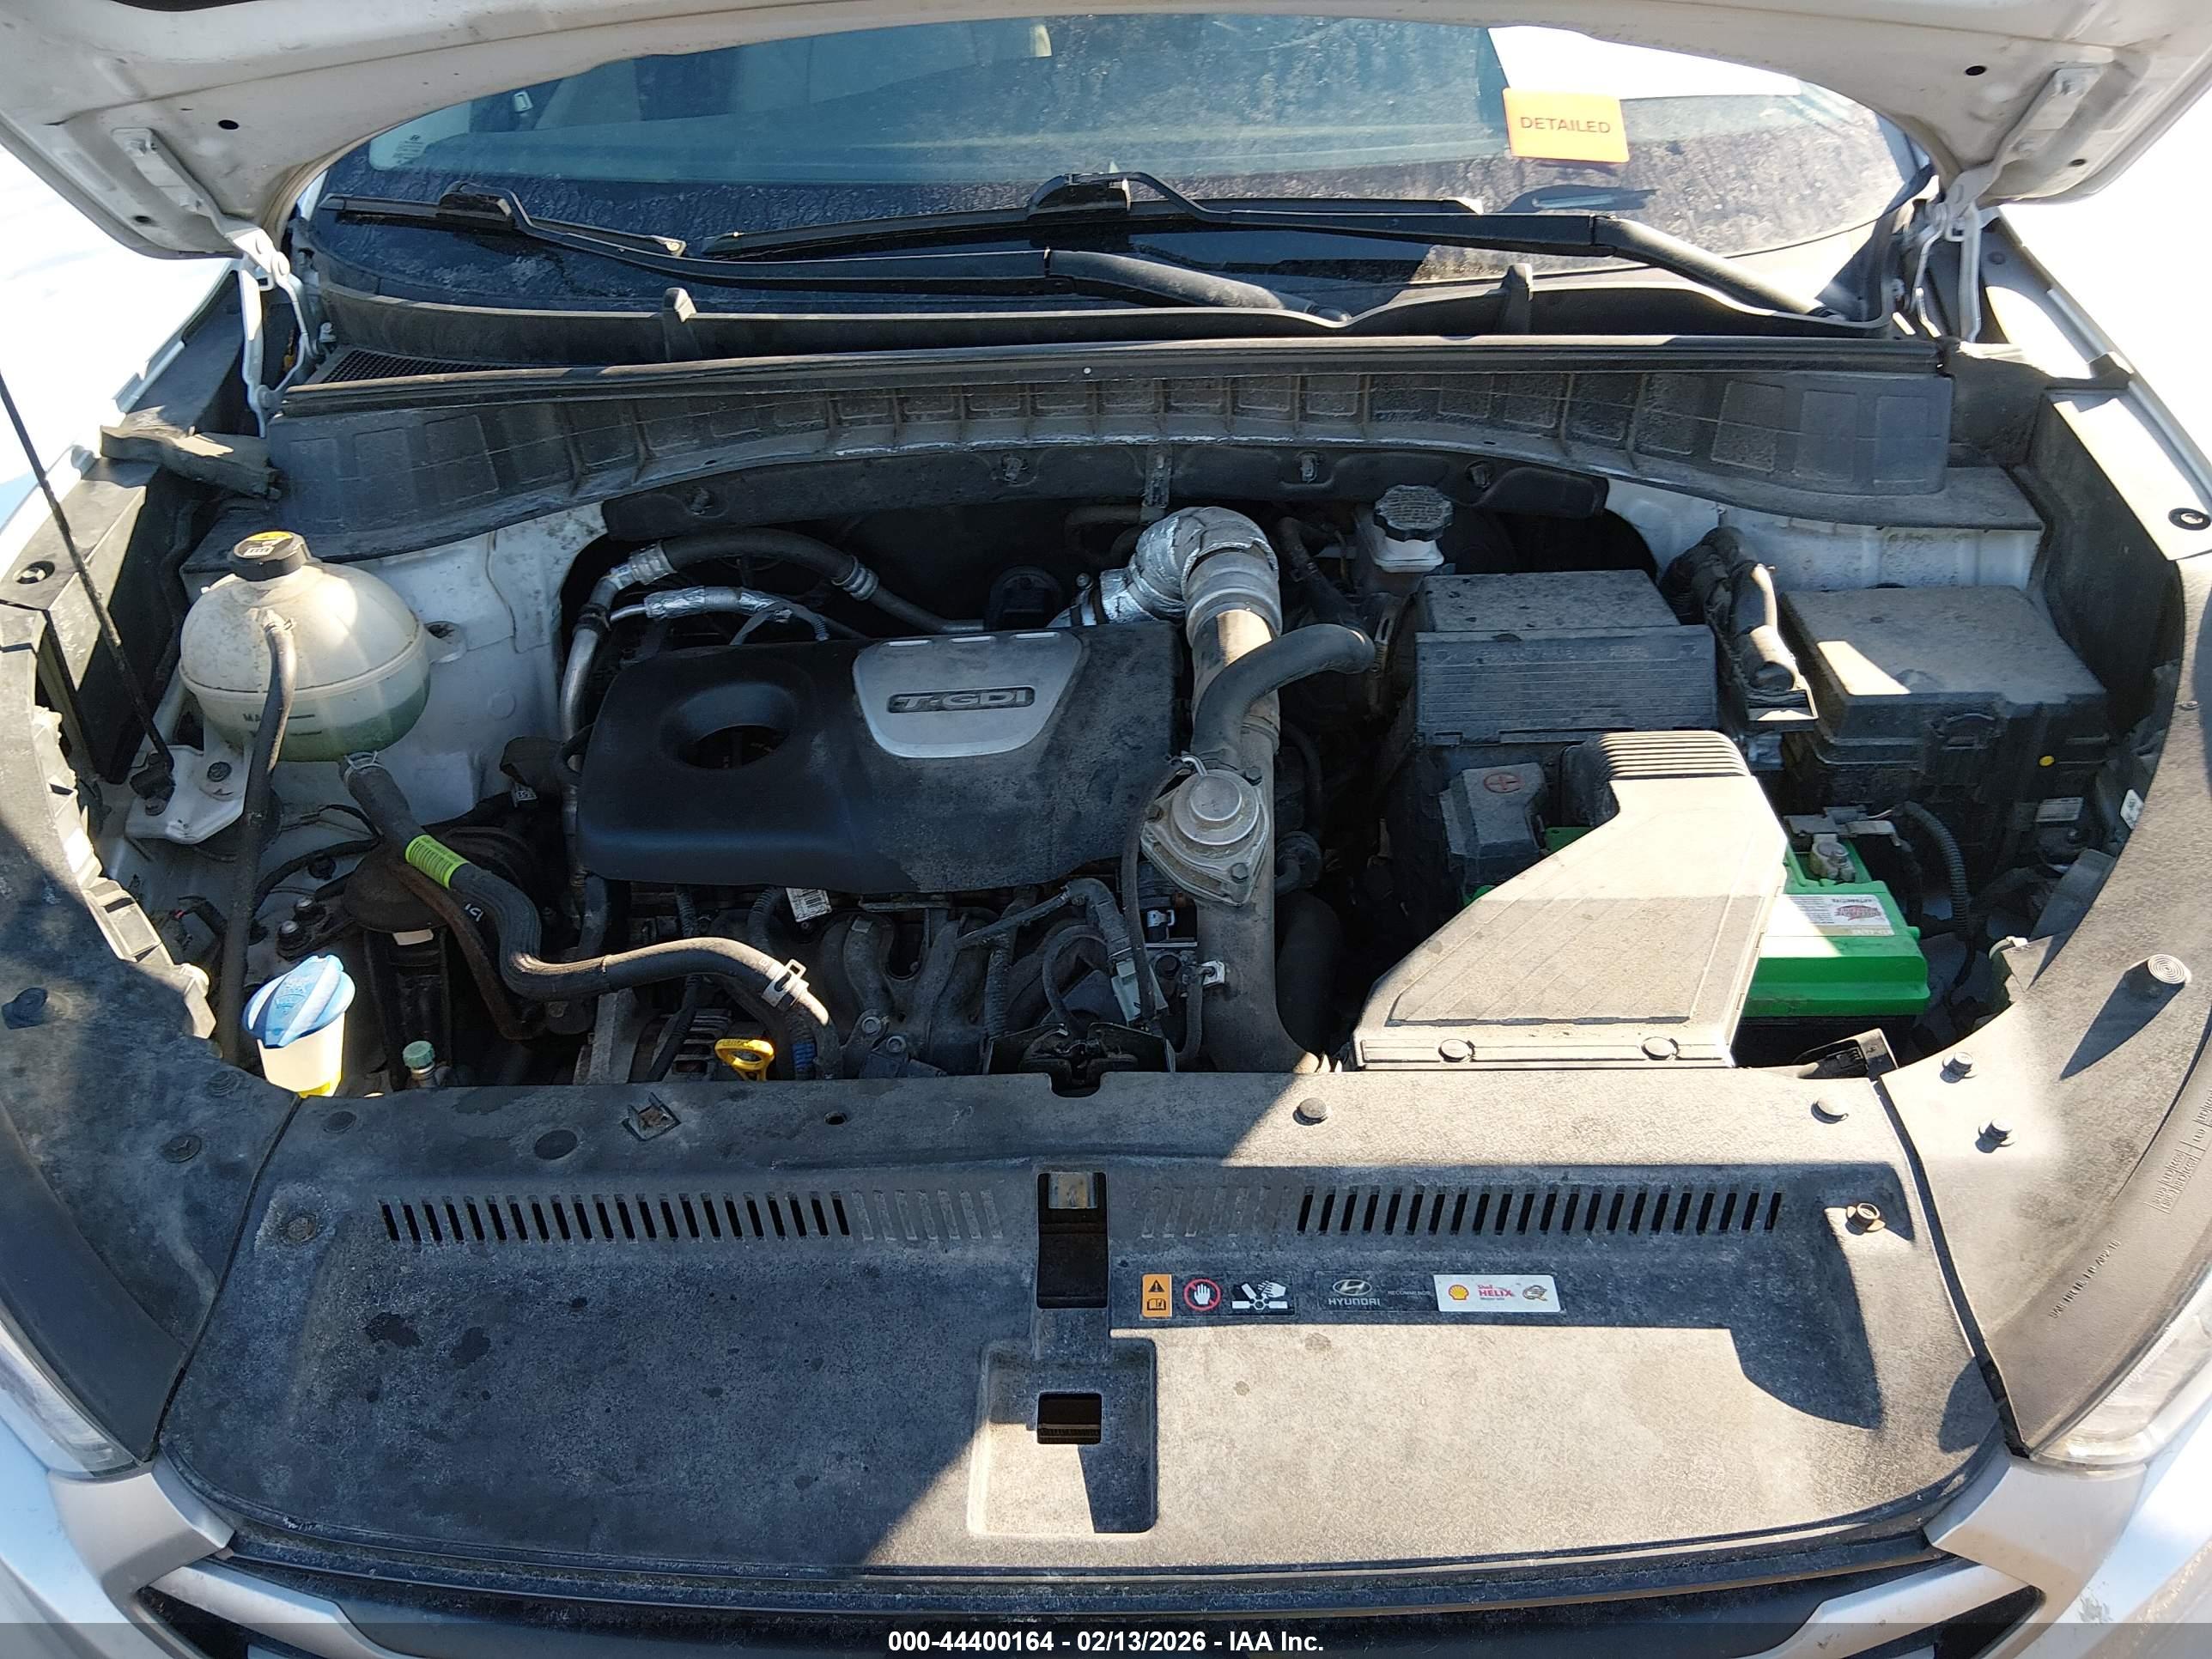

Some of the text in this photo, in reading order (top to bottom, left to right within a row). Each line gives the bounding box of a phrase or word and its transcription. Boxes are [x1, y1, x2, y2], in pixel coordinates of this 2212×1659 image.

[1520, 117, 1611, 133] DETAILED
[898, 690, 1026, 709] T-GDI
[1328, 1297, 1382, 1306] HYUNDAI
